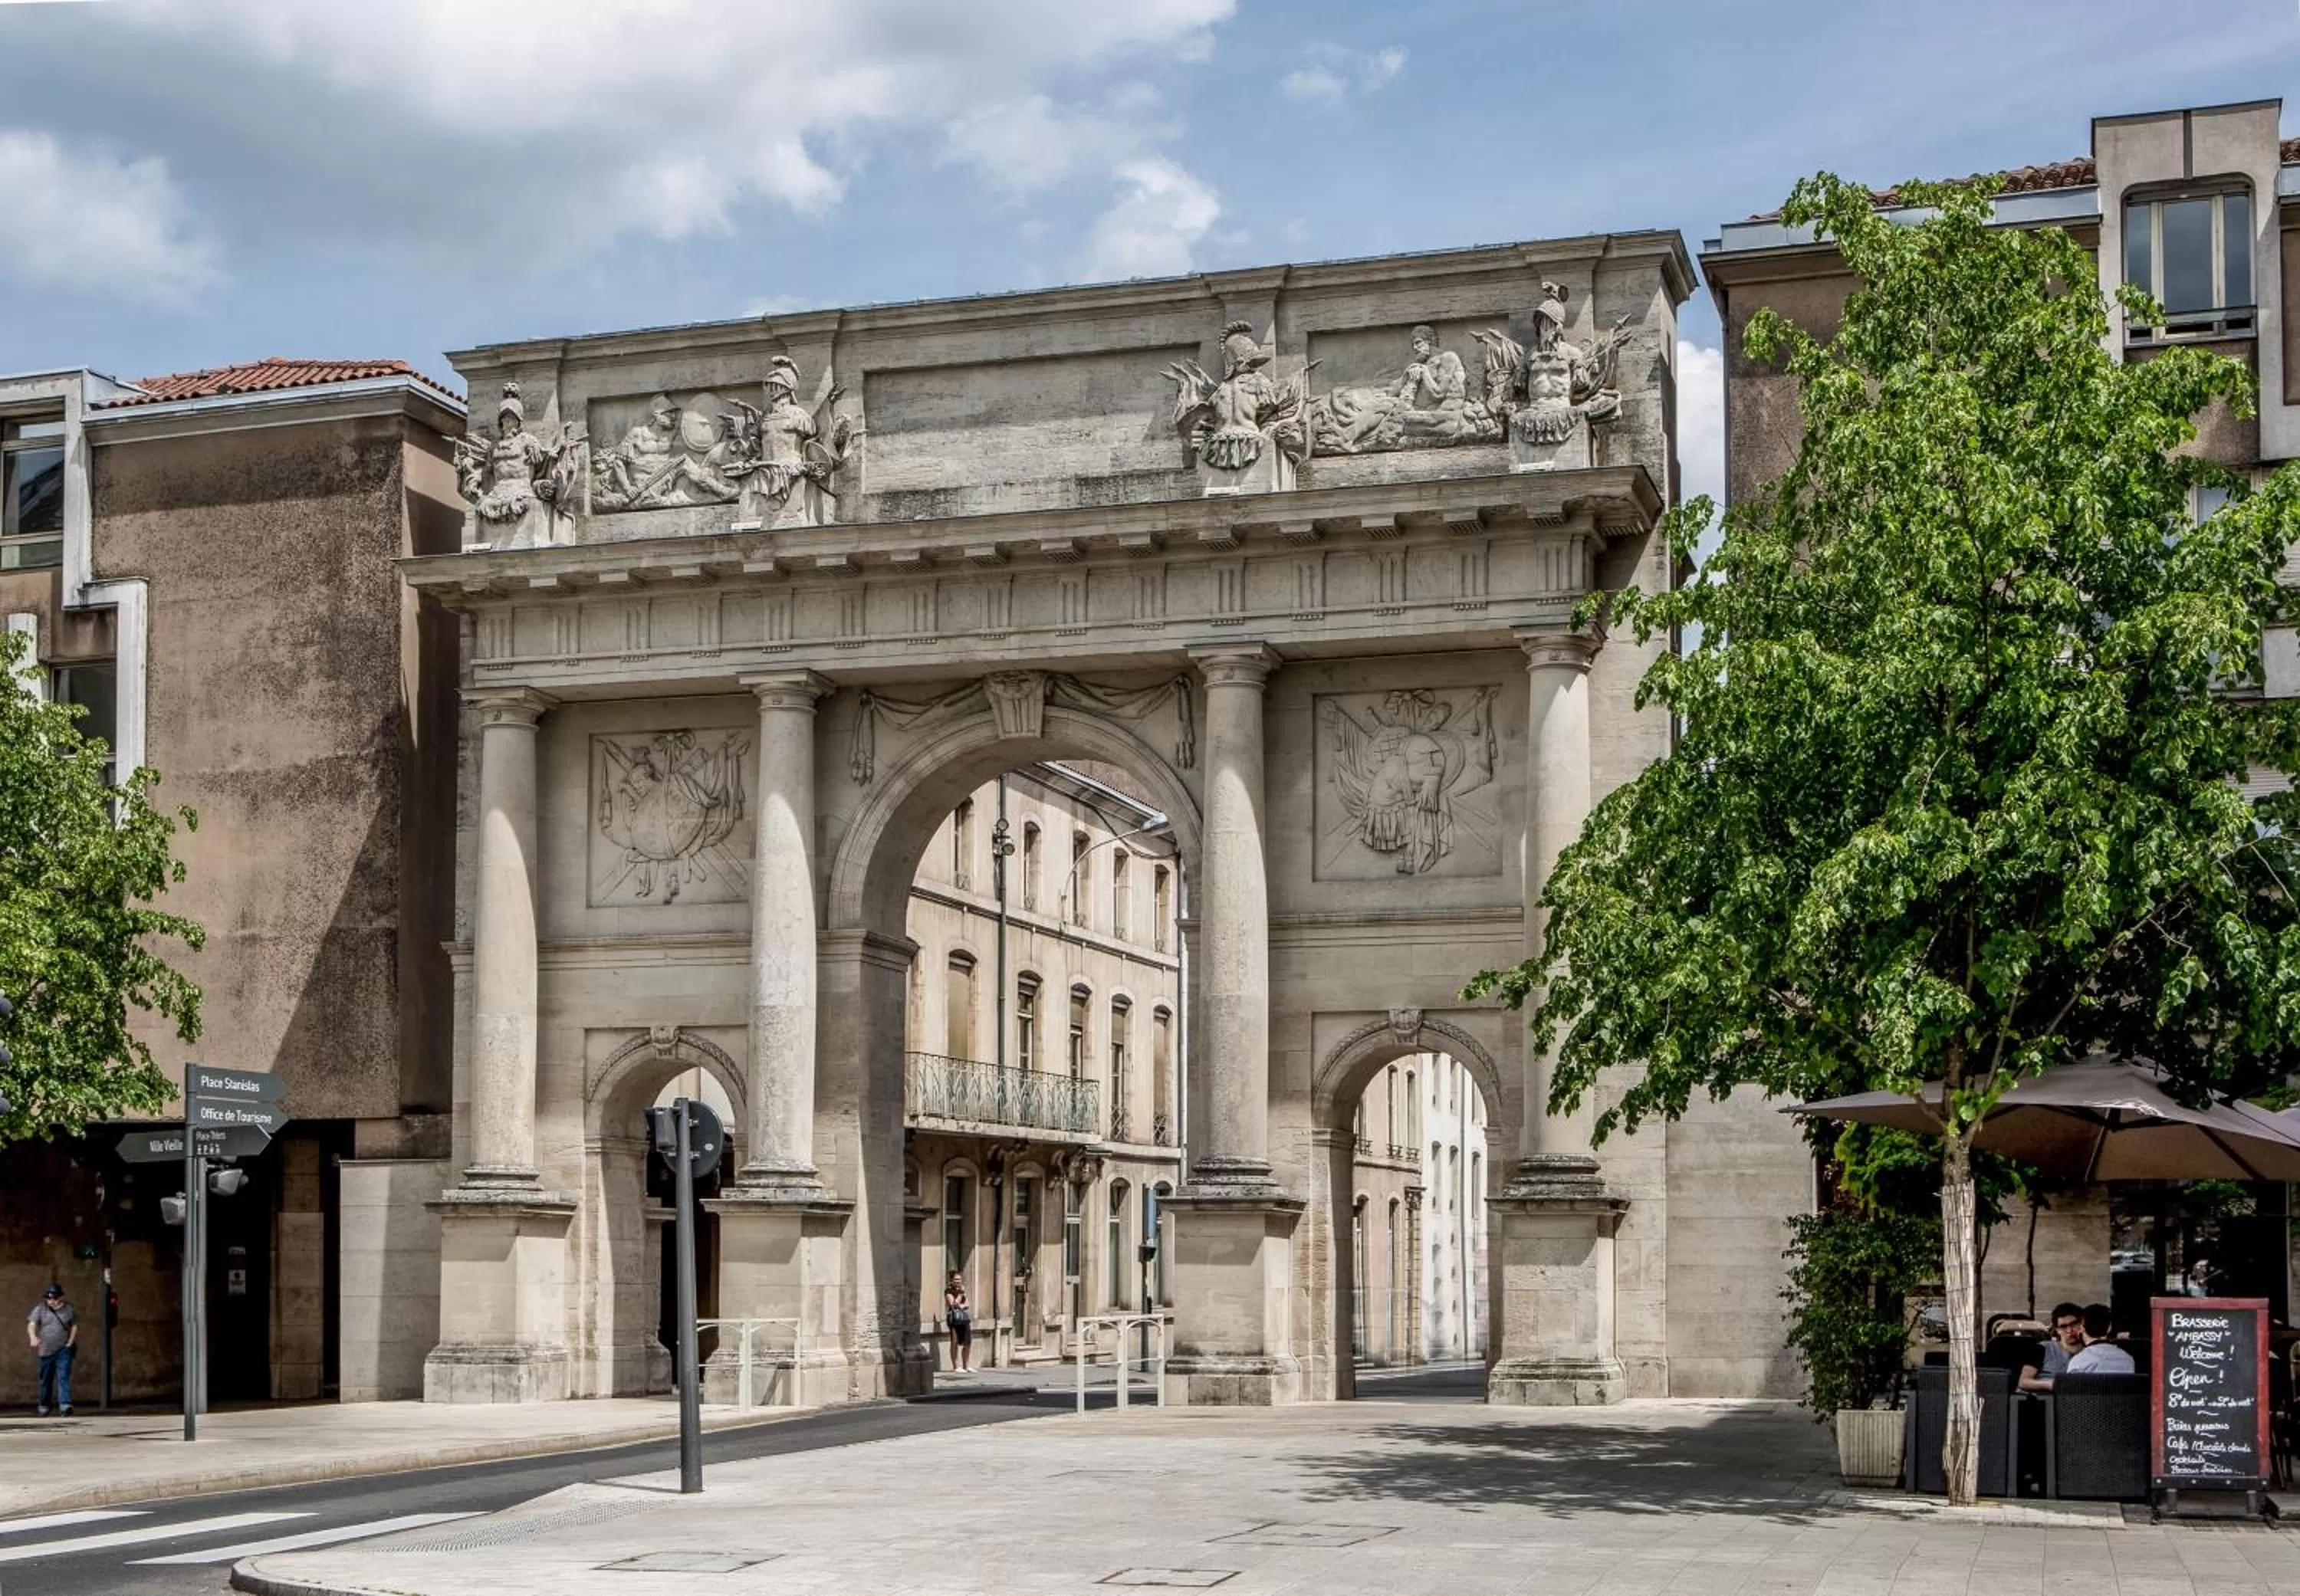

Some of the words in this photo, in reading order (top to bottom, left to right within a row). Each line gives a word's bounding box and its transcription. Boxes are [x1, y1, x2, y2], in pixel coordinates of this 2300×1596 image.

[201, 1075, 223, 1089] Place
[225, 1077, 260, 1092] Stanislas
[201, 1107, 224, 1120] Office
[225, 1110, 235, 1121] de
[236, 1110, 272, 1125] Tourisme
[164, 1139, 183, 1151] Vieille
[2180, 1345, 2225, 1361] Welcome
[2170, 1367, 2215, 1390] Open
